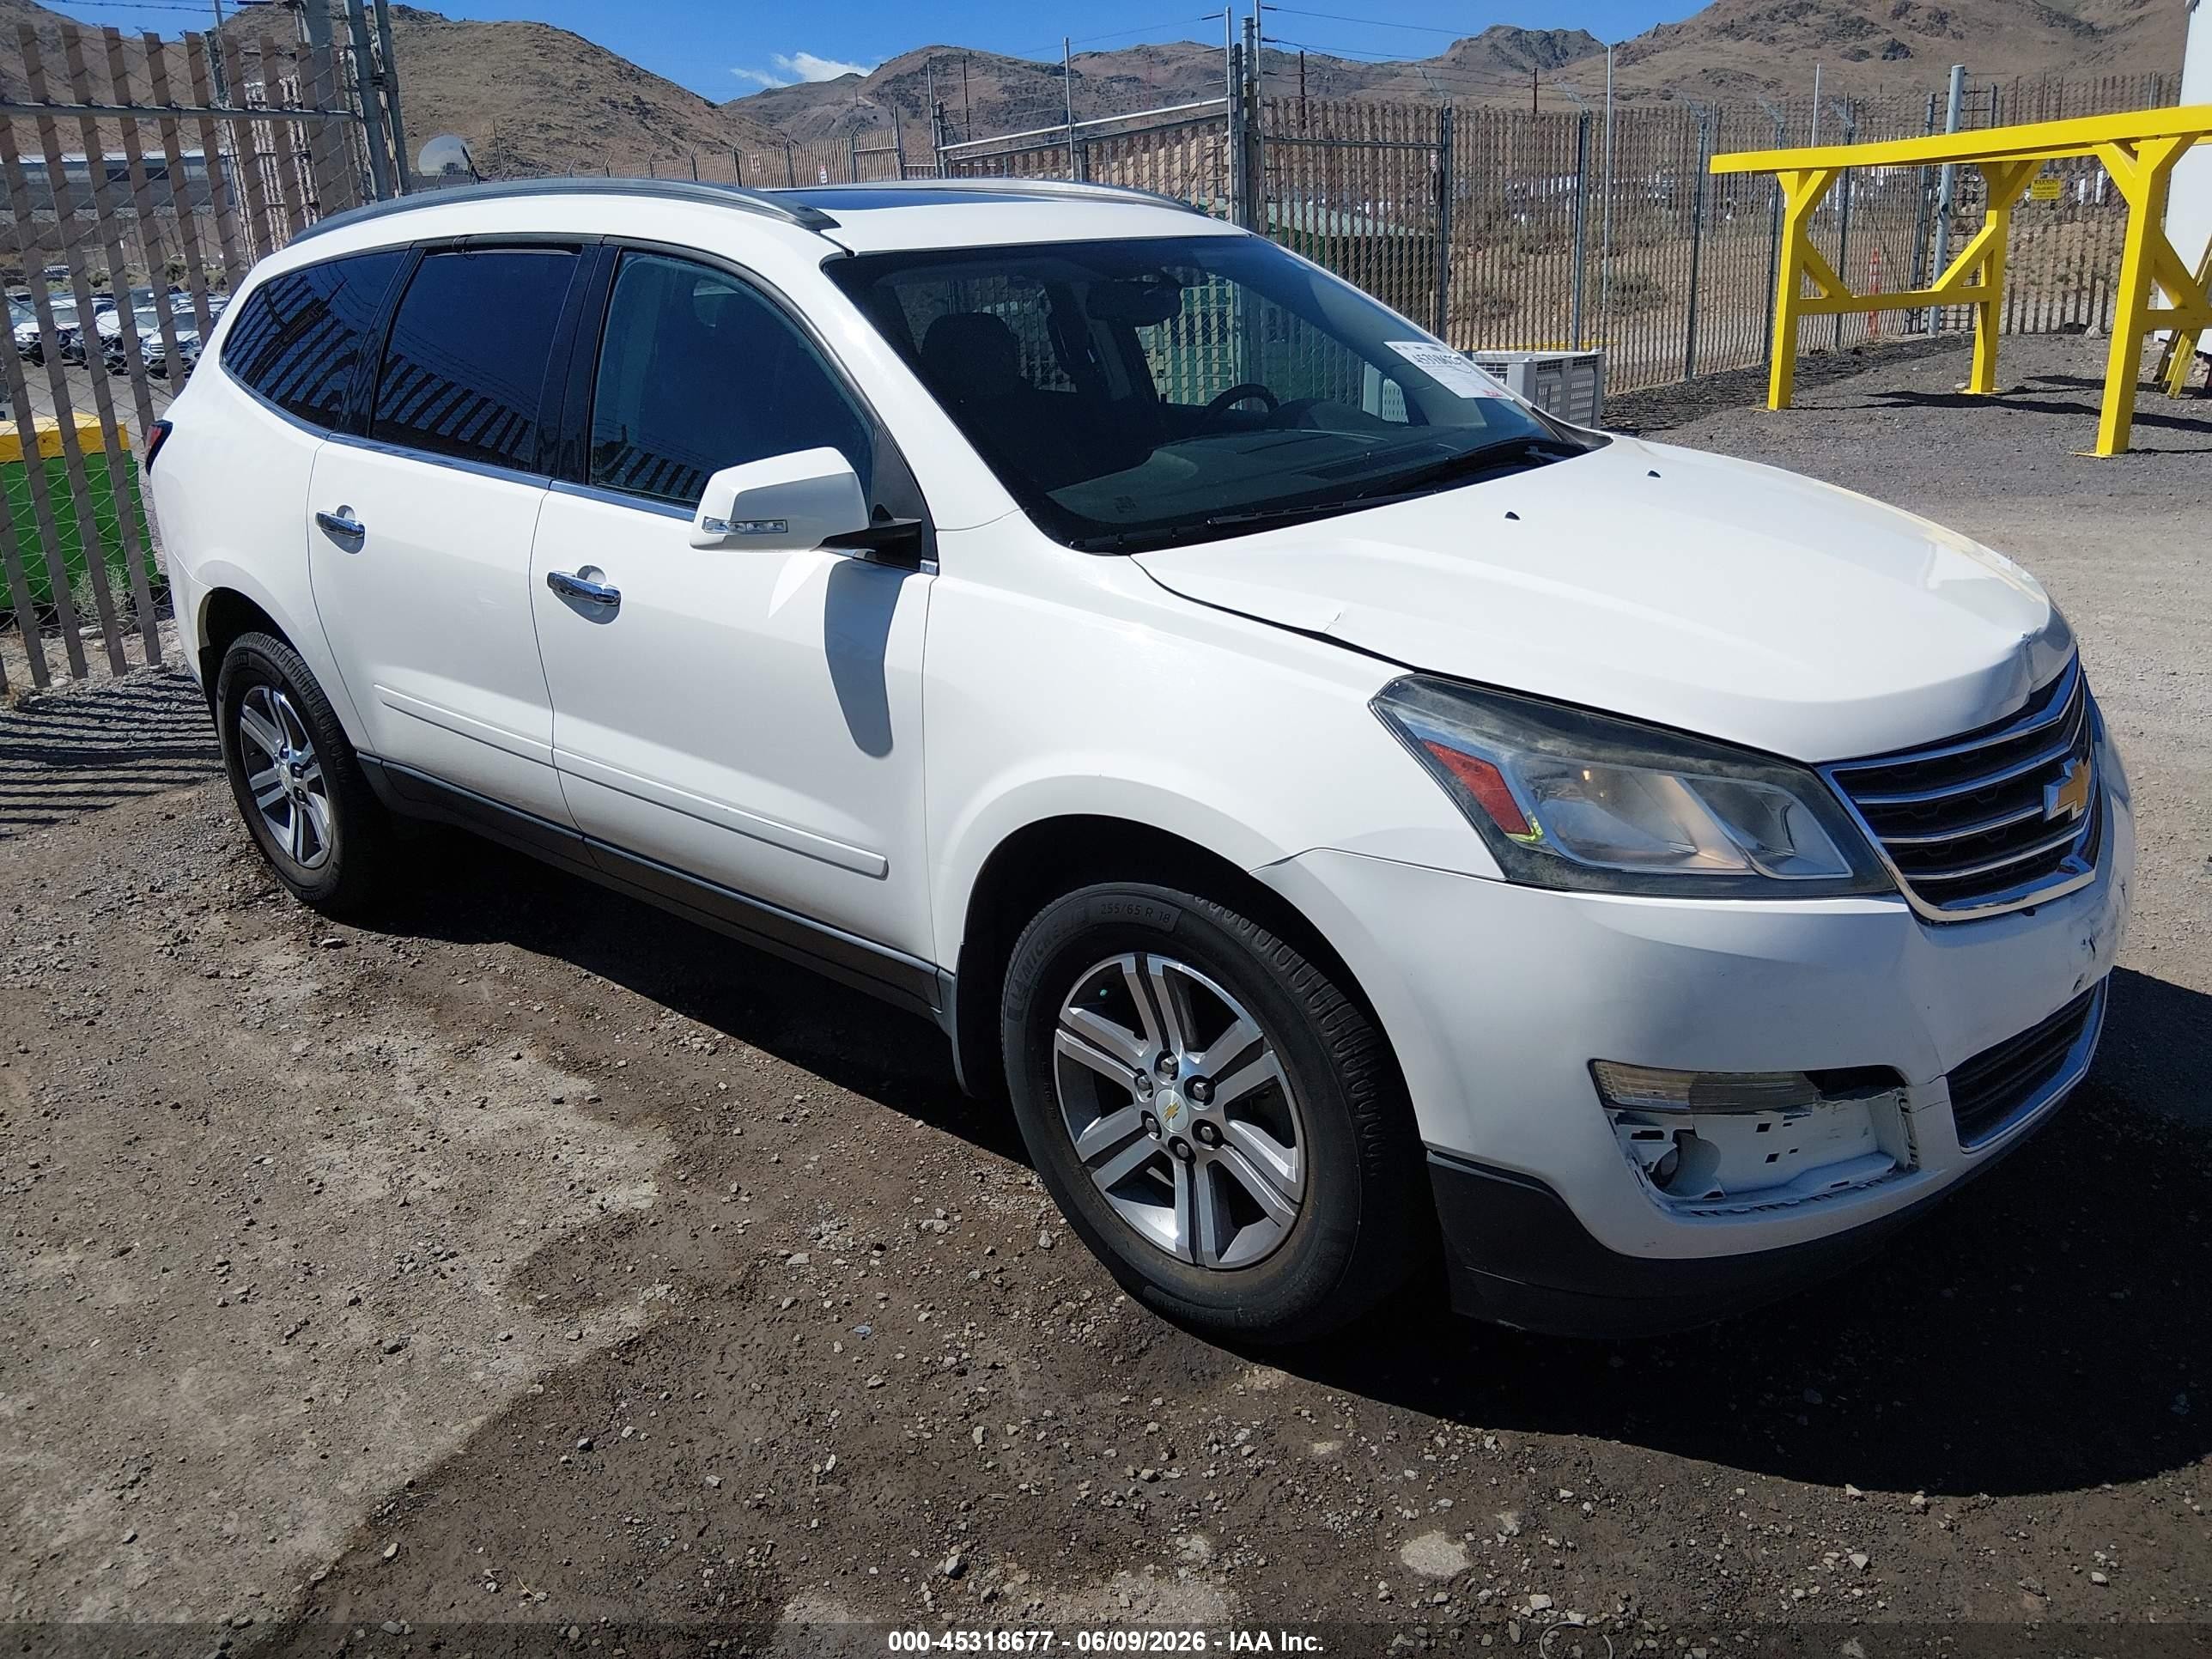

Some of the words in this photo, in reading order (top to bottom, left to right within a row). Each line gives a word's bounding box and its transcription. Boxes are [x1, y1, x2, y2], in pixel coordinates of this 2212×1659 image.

[1100, 903, 1141, 915] 255/65
[1146, 906, 1154, 918] R
[1158, 911, 1171, 924] 18
